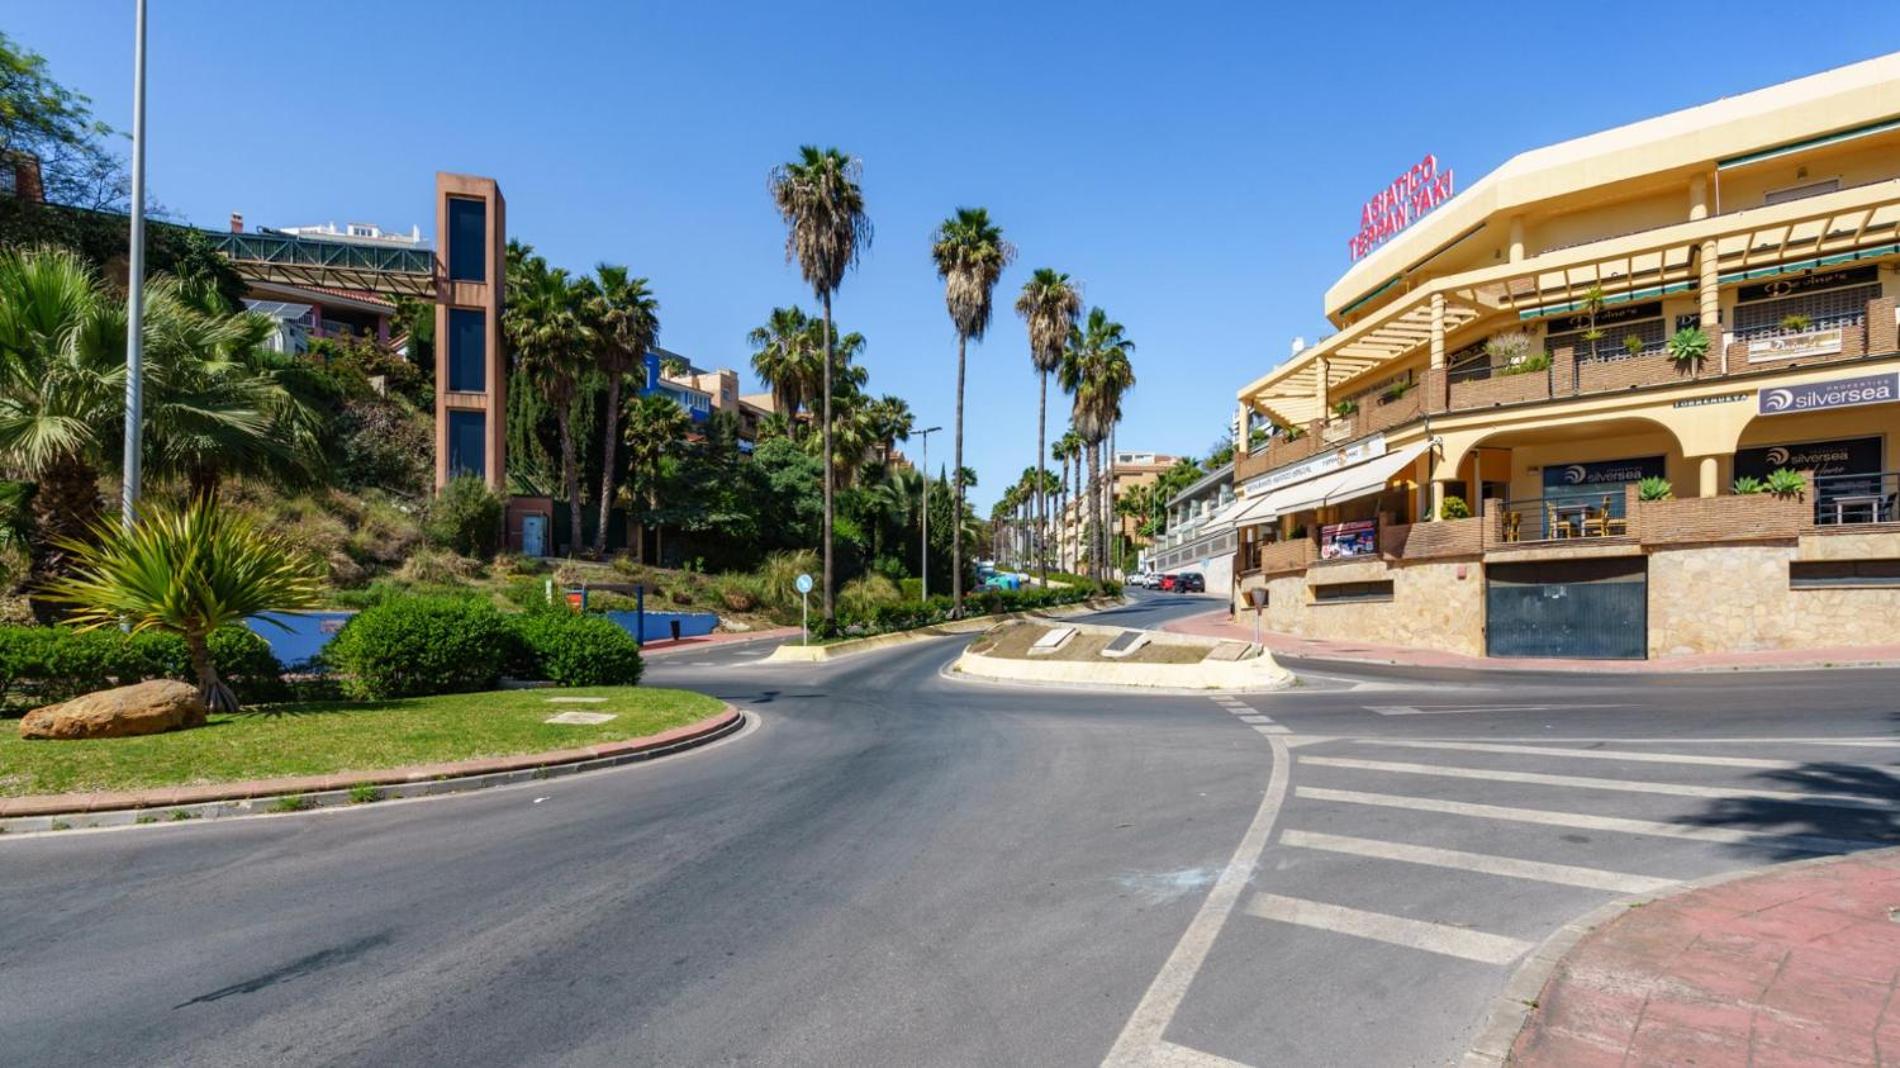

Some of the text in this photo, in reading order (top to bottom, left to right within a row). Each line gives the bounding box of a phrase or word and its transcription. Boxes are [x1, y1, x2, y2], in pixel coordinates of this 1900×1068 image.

[1361, 154, 1436, 226] ASIATICO
[1350, 169, 1453, 261] TEPPAN YAKI
[1826, 379, 1889, 391] PROPERTIES
[1796, 386, 1891, 408] silversea
[1791, 452, 1849, 464] silversea
[1587, 470, 1642, 483] silversea
